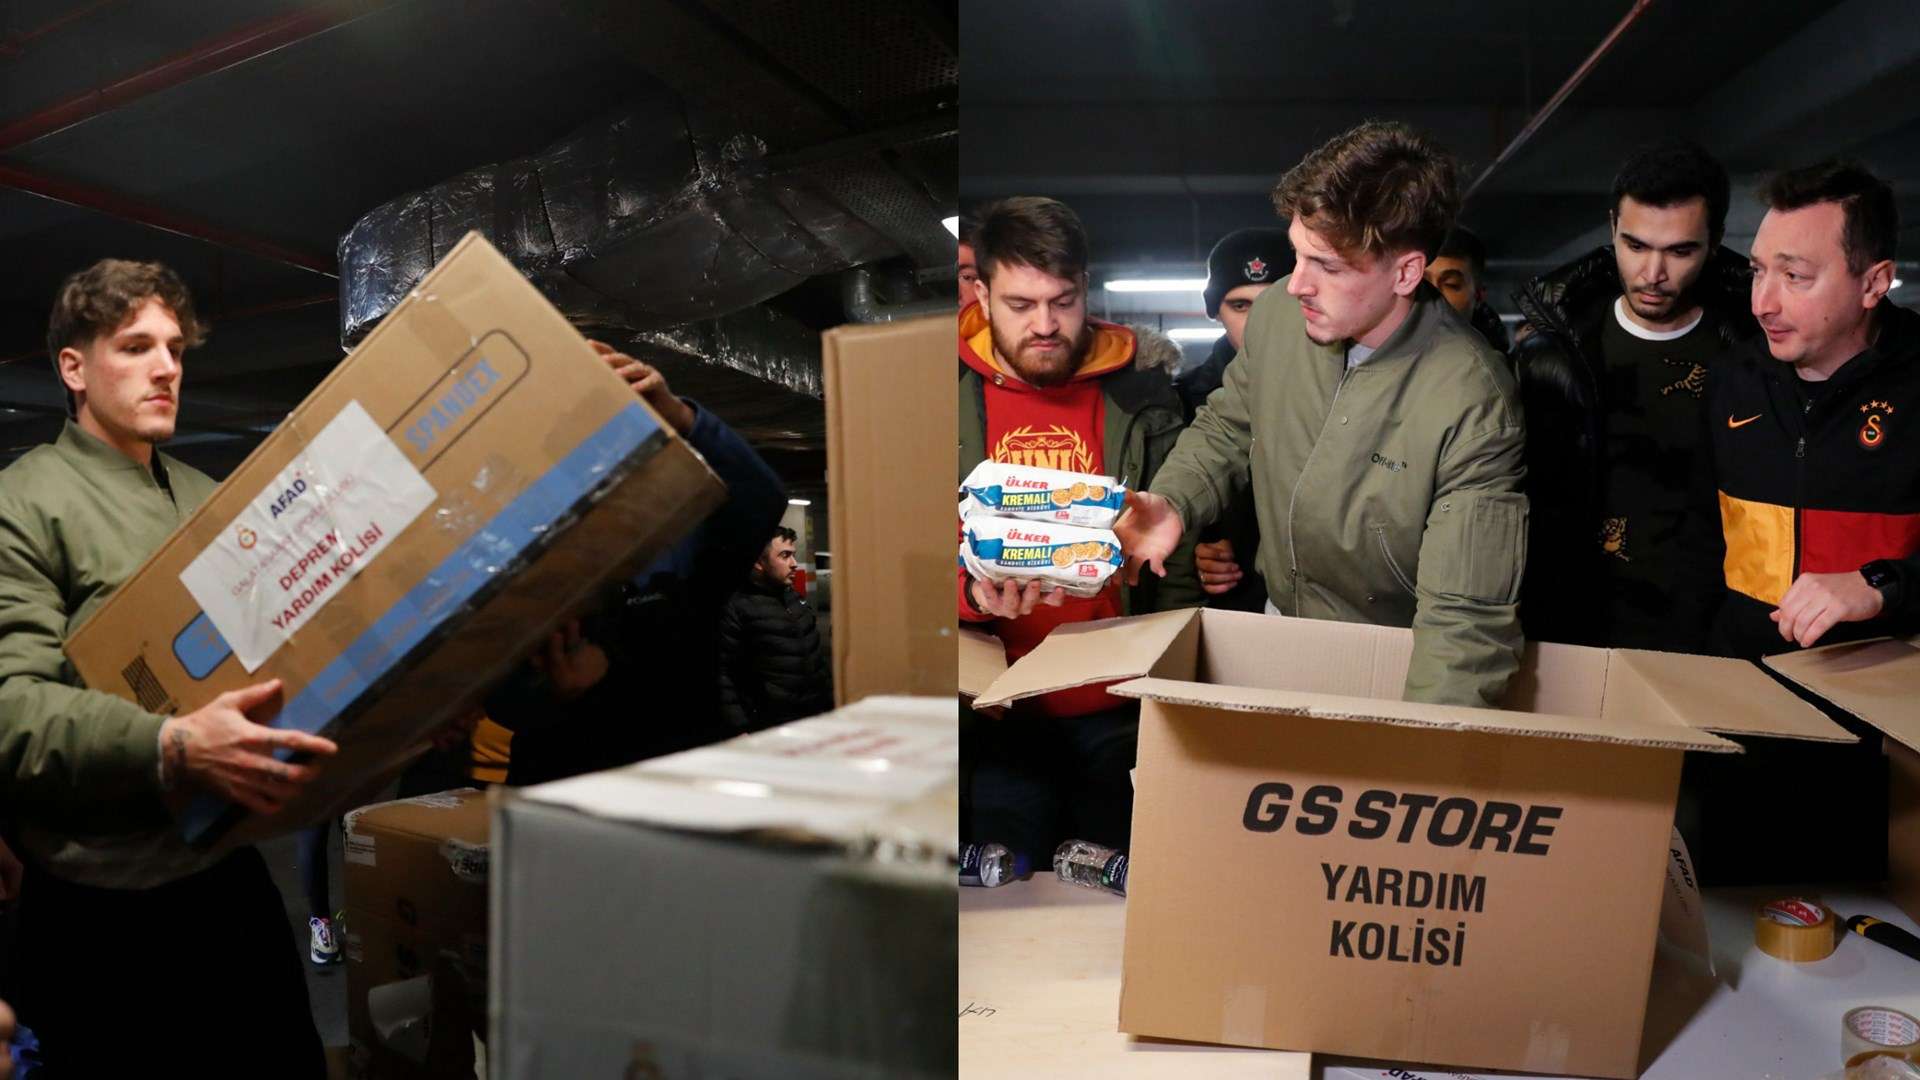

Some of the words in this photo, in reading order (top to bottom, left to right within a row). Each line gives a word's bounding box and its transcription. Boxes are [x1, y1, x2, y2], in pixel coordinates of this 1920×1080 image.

[404, 358, 501, 453] SPANDEX
[269, 478, 307, 519] AFAD
[1002, 492, 1051, 506] KREMALI
[1005, 475, 1049, 490] ÜLKER
[1002, 546, 1052, 560] KREMALI
[1007, 528, 1050, 544] ÜLKER
[272, 573, 332, 631] YARDIM
[331, 521, 384, 577] KOLİSİ
[279, 527, 340, 591] DEPREM
[1242, 781, 1344, 836] GS
[1348, 789, 1564, 856] STORE
[1320, 862, 1487, 913] YARDIM
[1669, 848, 1693, 888] AFAD
[1329, 918, 1466, 967] KOLİSİ
